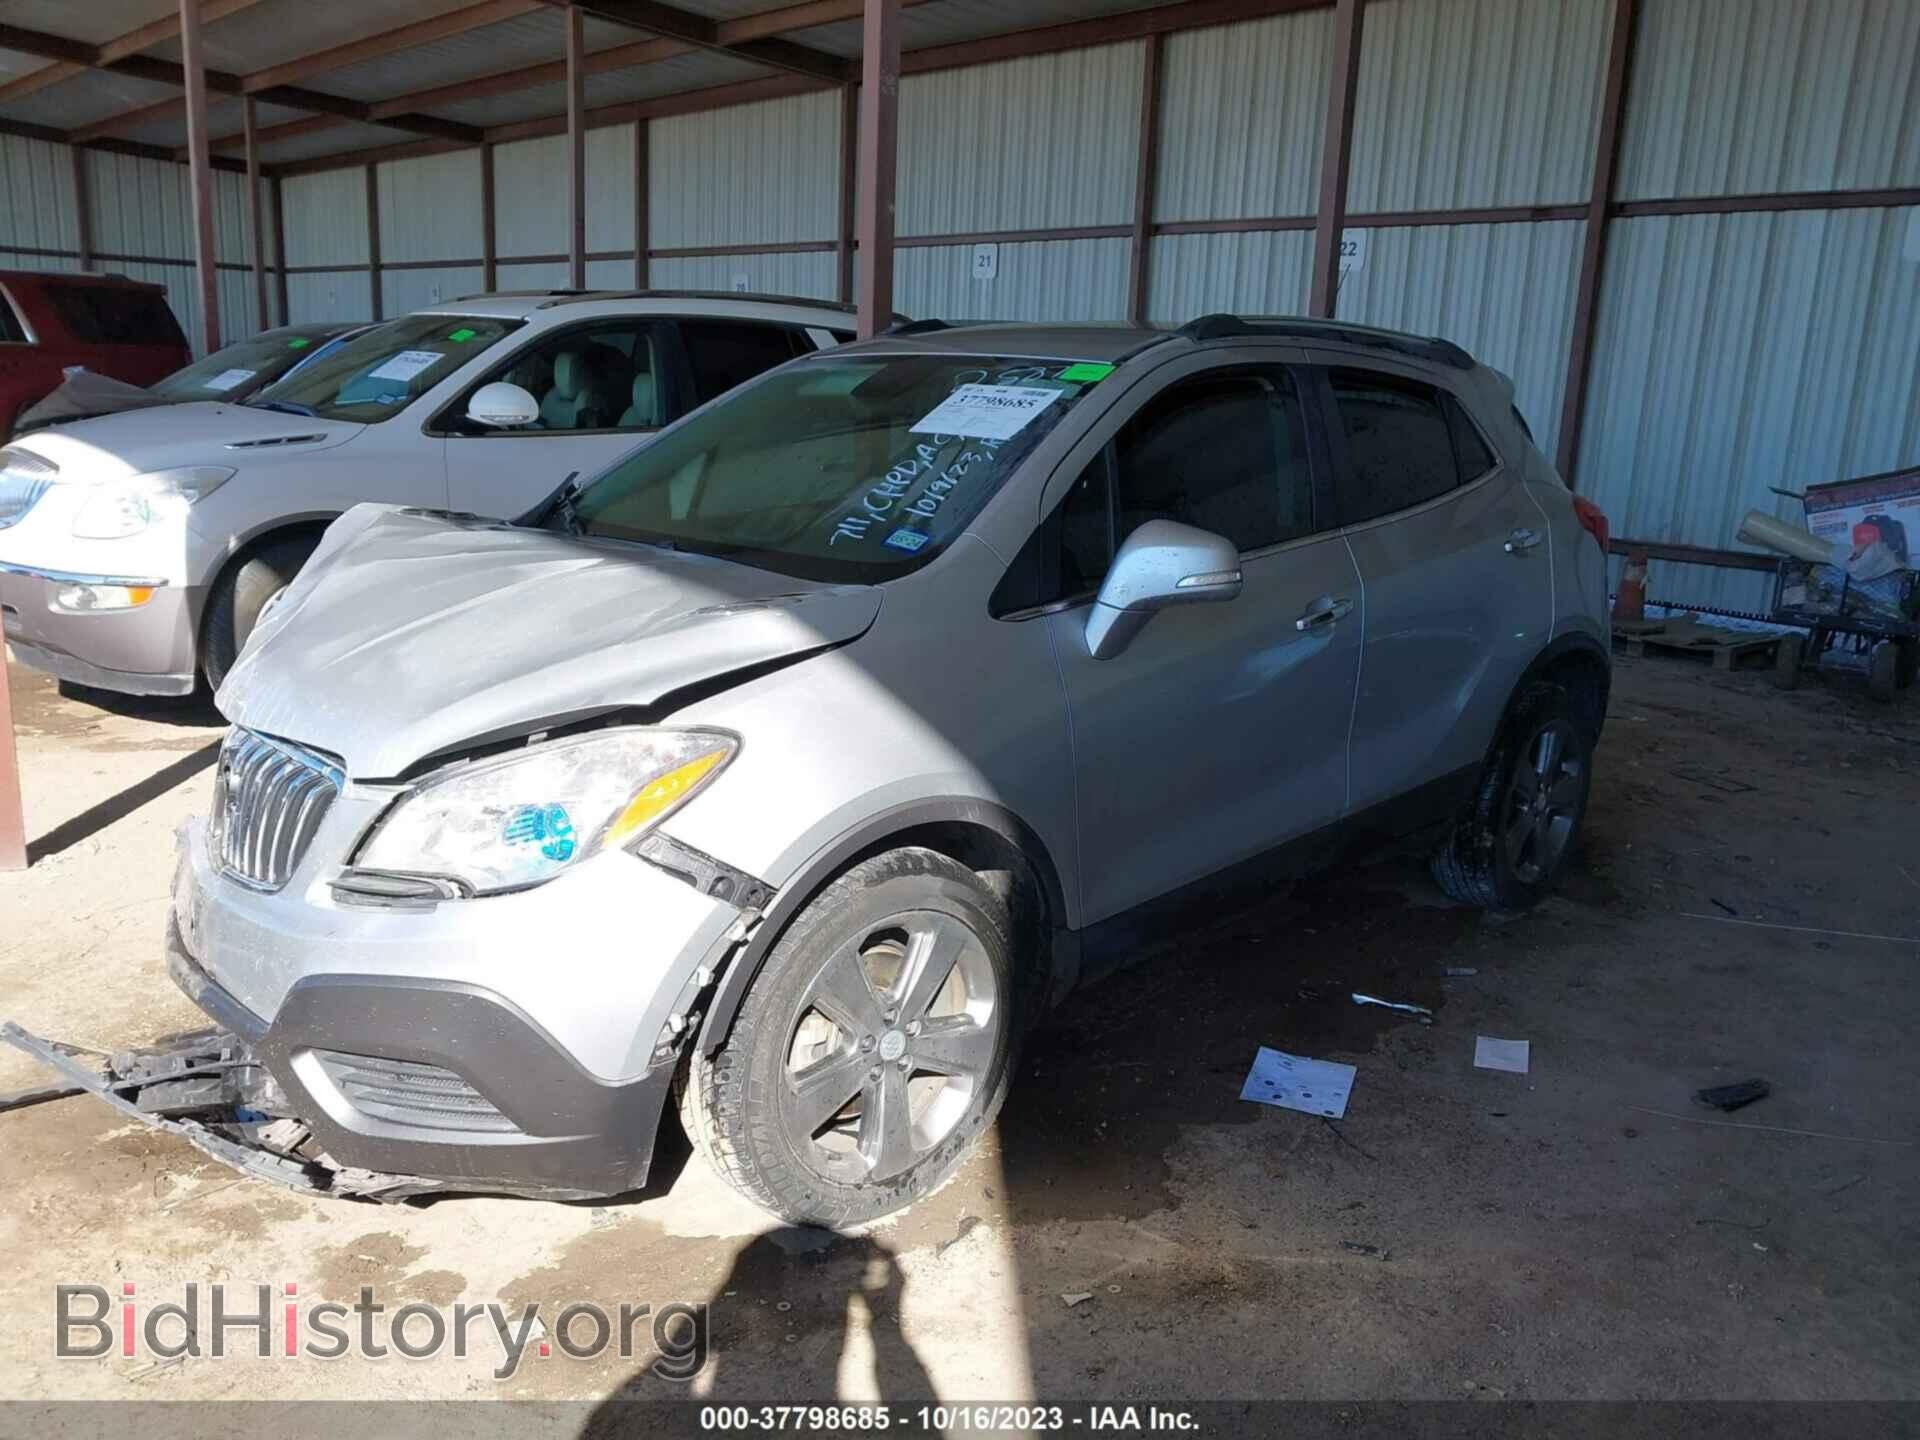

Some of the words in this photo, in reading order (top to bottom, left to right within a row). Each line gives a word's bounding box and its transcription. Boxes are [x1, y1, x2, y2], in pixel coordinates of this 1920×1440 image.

[1339, 241, 1358, 256] 22
[978, 255, 992, 268] 21
[953, 395, 1038, 409] 37798685
